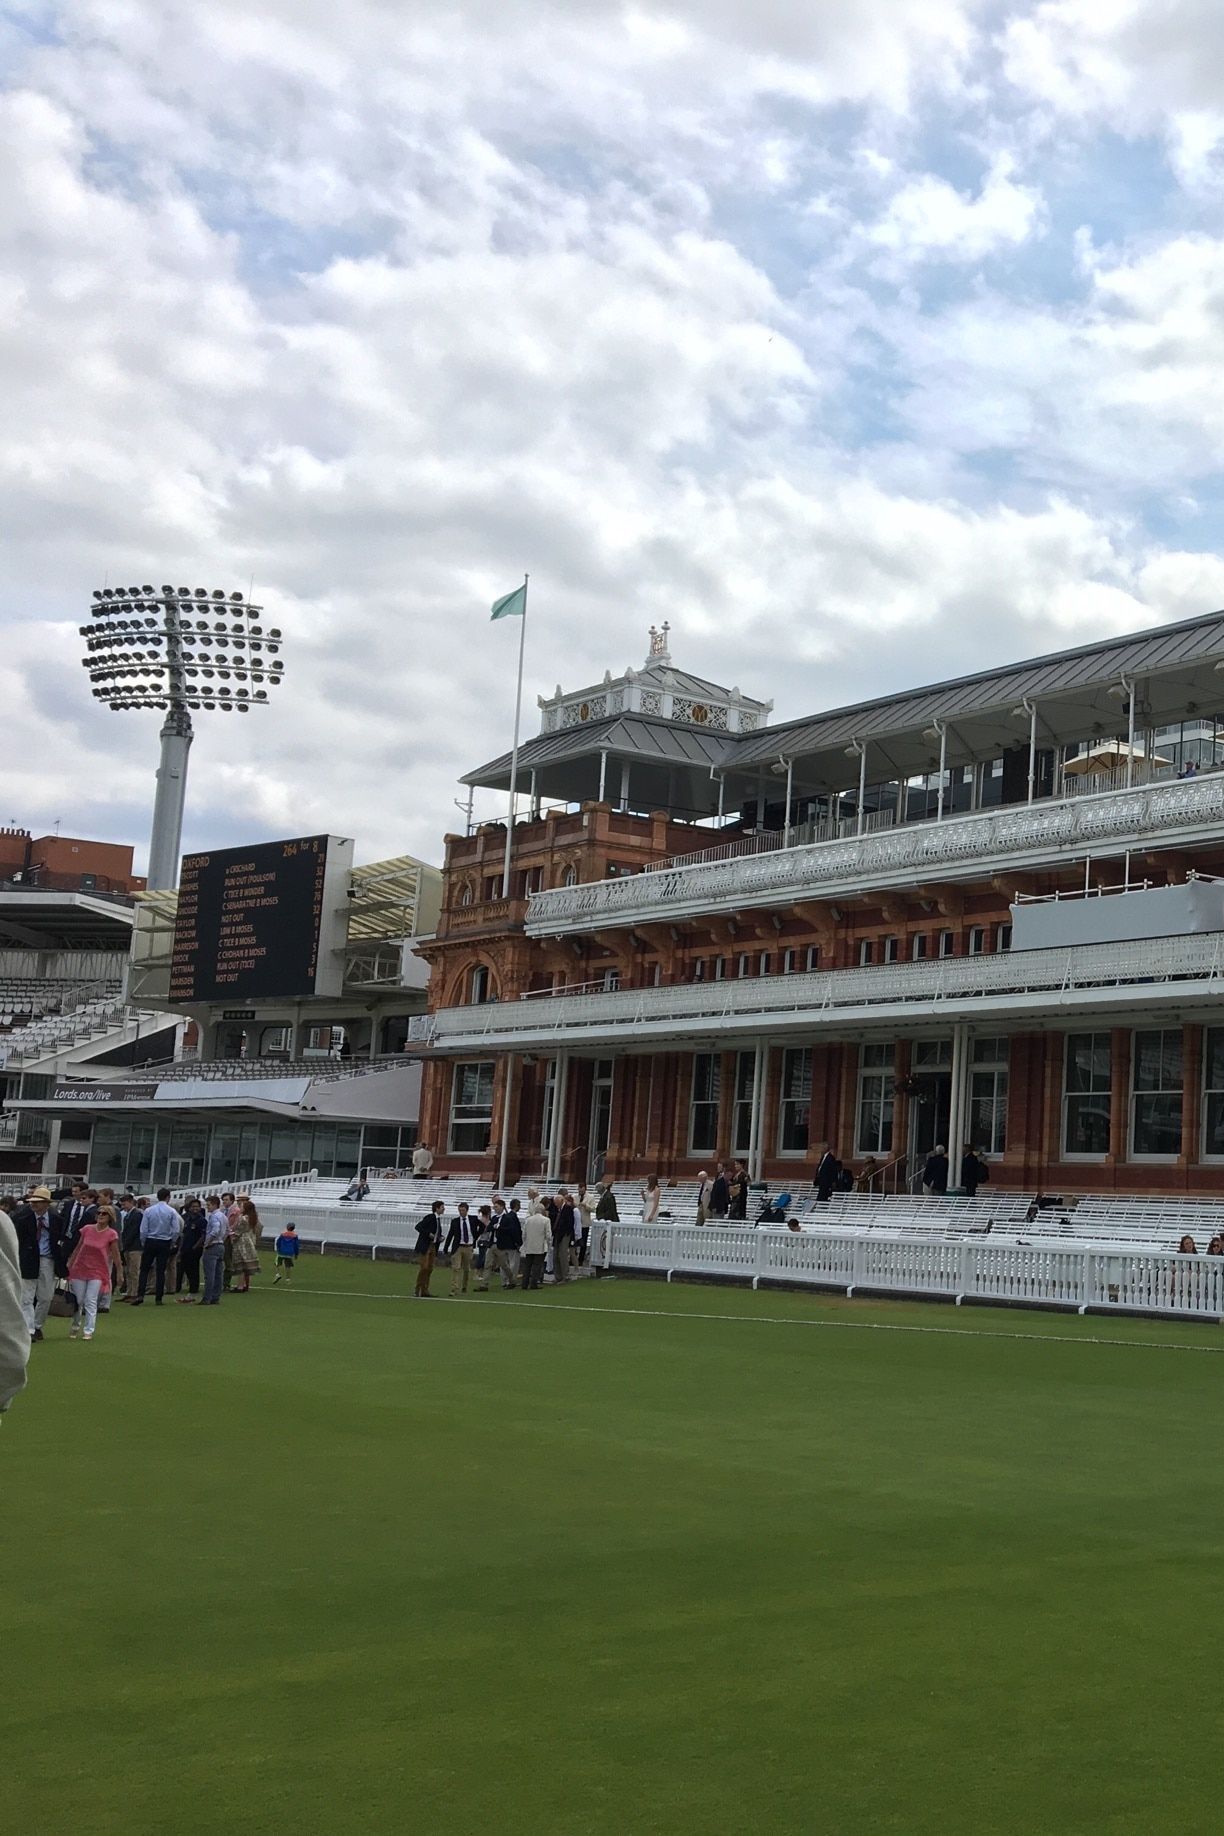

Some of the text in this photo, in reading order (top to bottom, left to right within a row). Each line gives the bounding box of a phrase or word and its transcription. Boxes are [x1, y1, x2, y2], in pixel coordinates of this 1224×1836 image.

[282, 843, 298, 857] 264
[312, 841, 319, 853] 8
[183, 856, 210, 870] OXFORD
